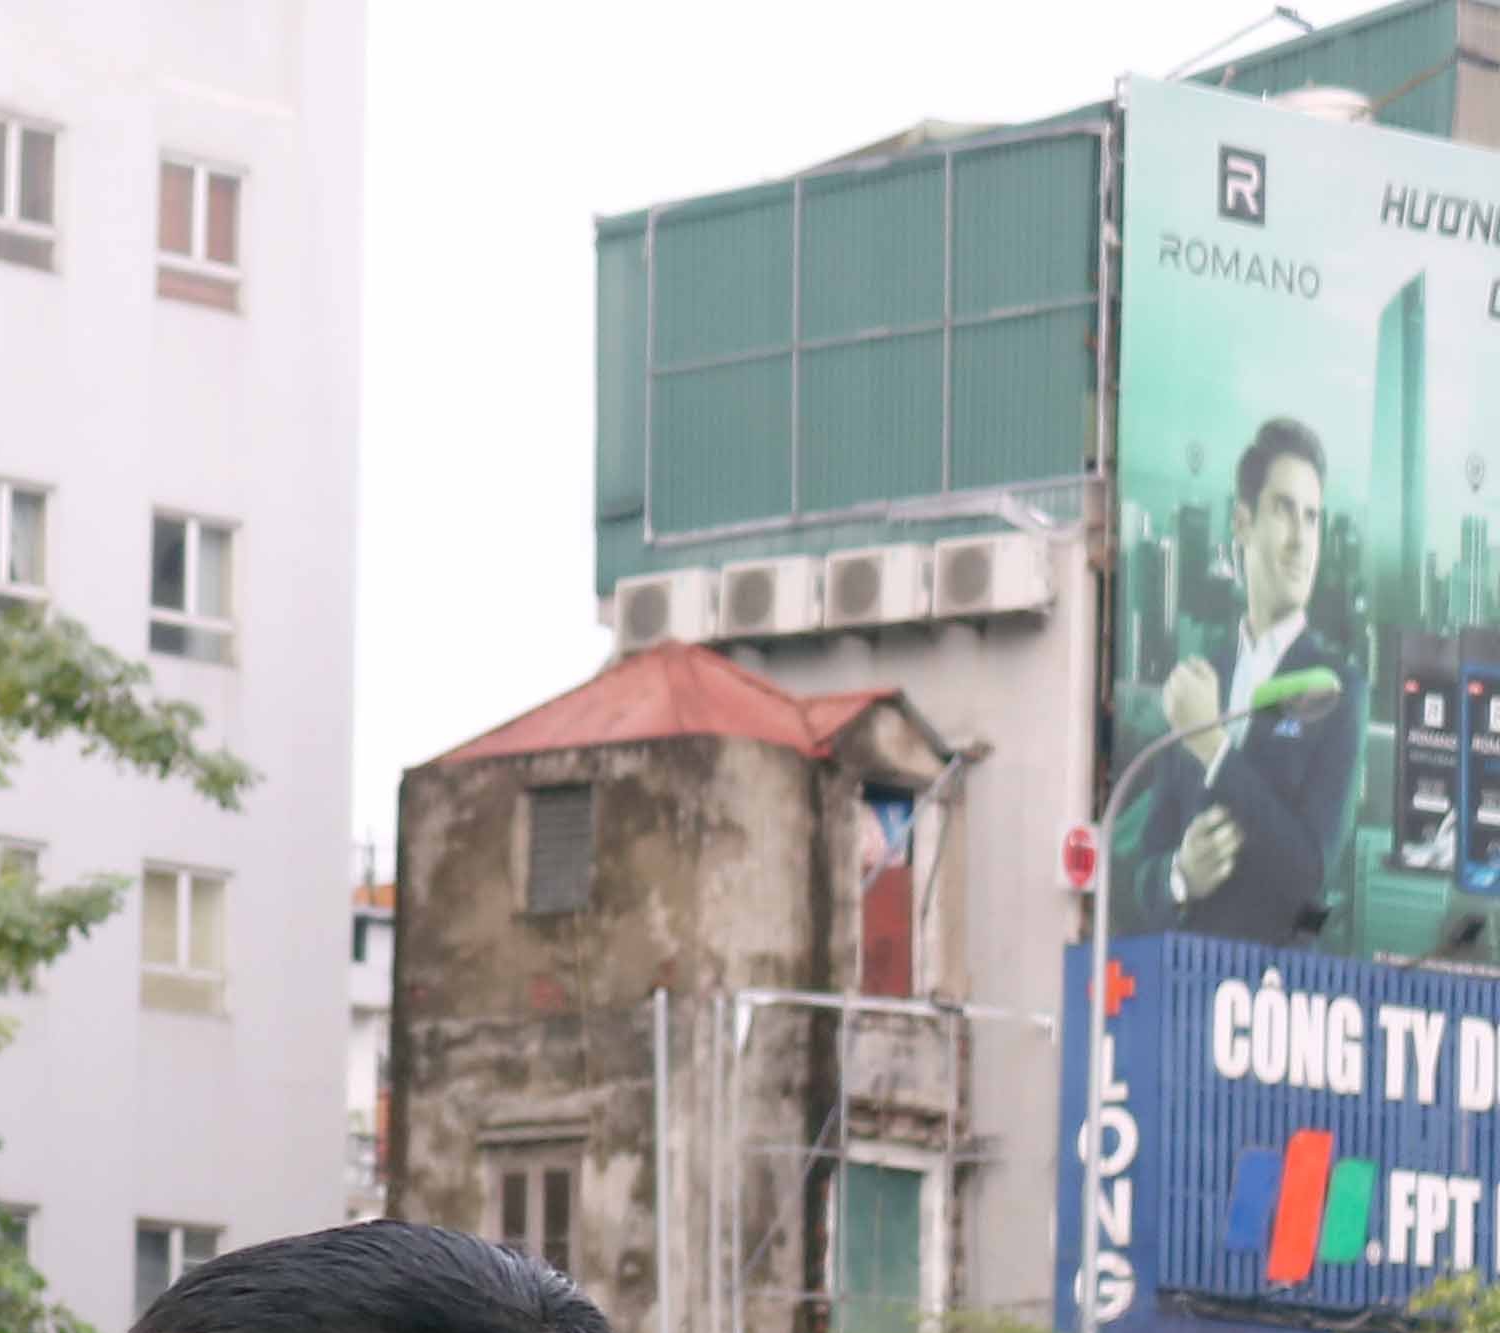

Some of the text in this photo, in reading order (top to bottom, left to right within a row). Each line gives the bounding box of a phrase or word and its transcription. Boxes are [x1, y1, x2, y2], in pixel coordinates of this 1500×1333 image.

[1157, 233, 1322, 300] ROMANO
[1212, 965, 1500, 1112] CÔNG TY D
[1388, 1169, 1482, 1272] FPT
